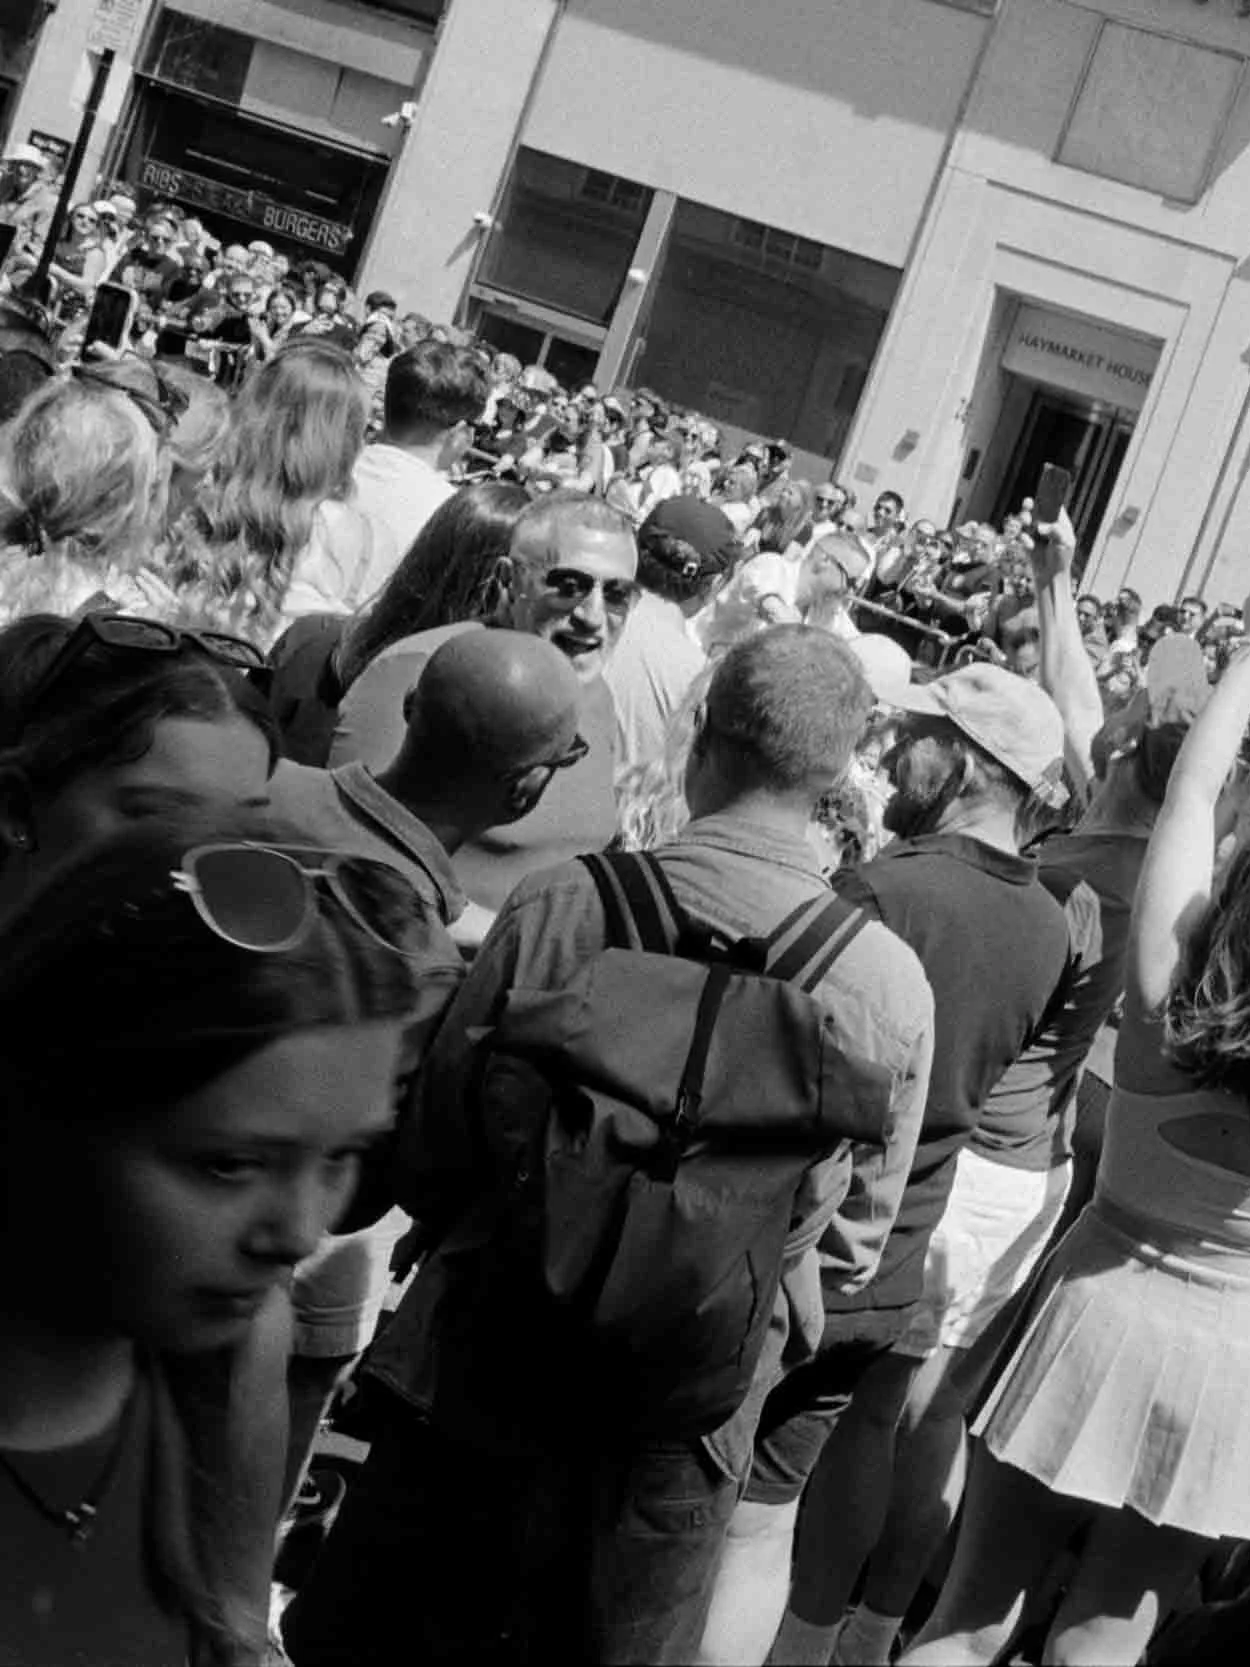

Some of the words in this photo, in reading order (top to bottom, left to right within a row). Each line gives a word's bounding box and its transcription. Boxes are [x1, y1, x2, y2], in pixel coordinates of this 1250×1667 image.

[143, 164, 182, 194] RIBS
[263, 205, 342, 249] BURGERS
[1018, 333, 1104, 368] HAYMARKET
